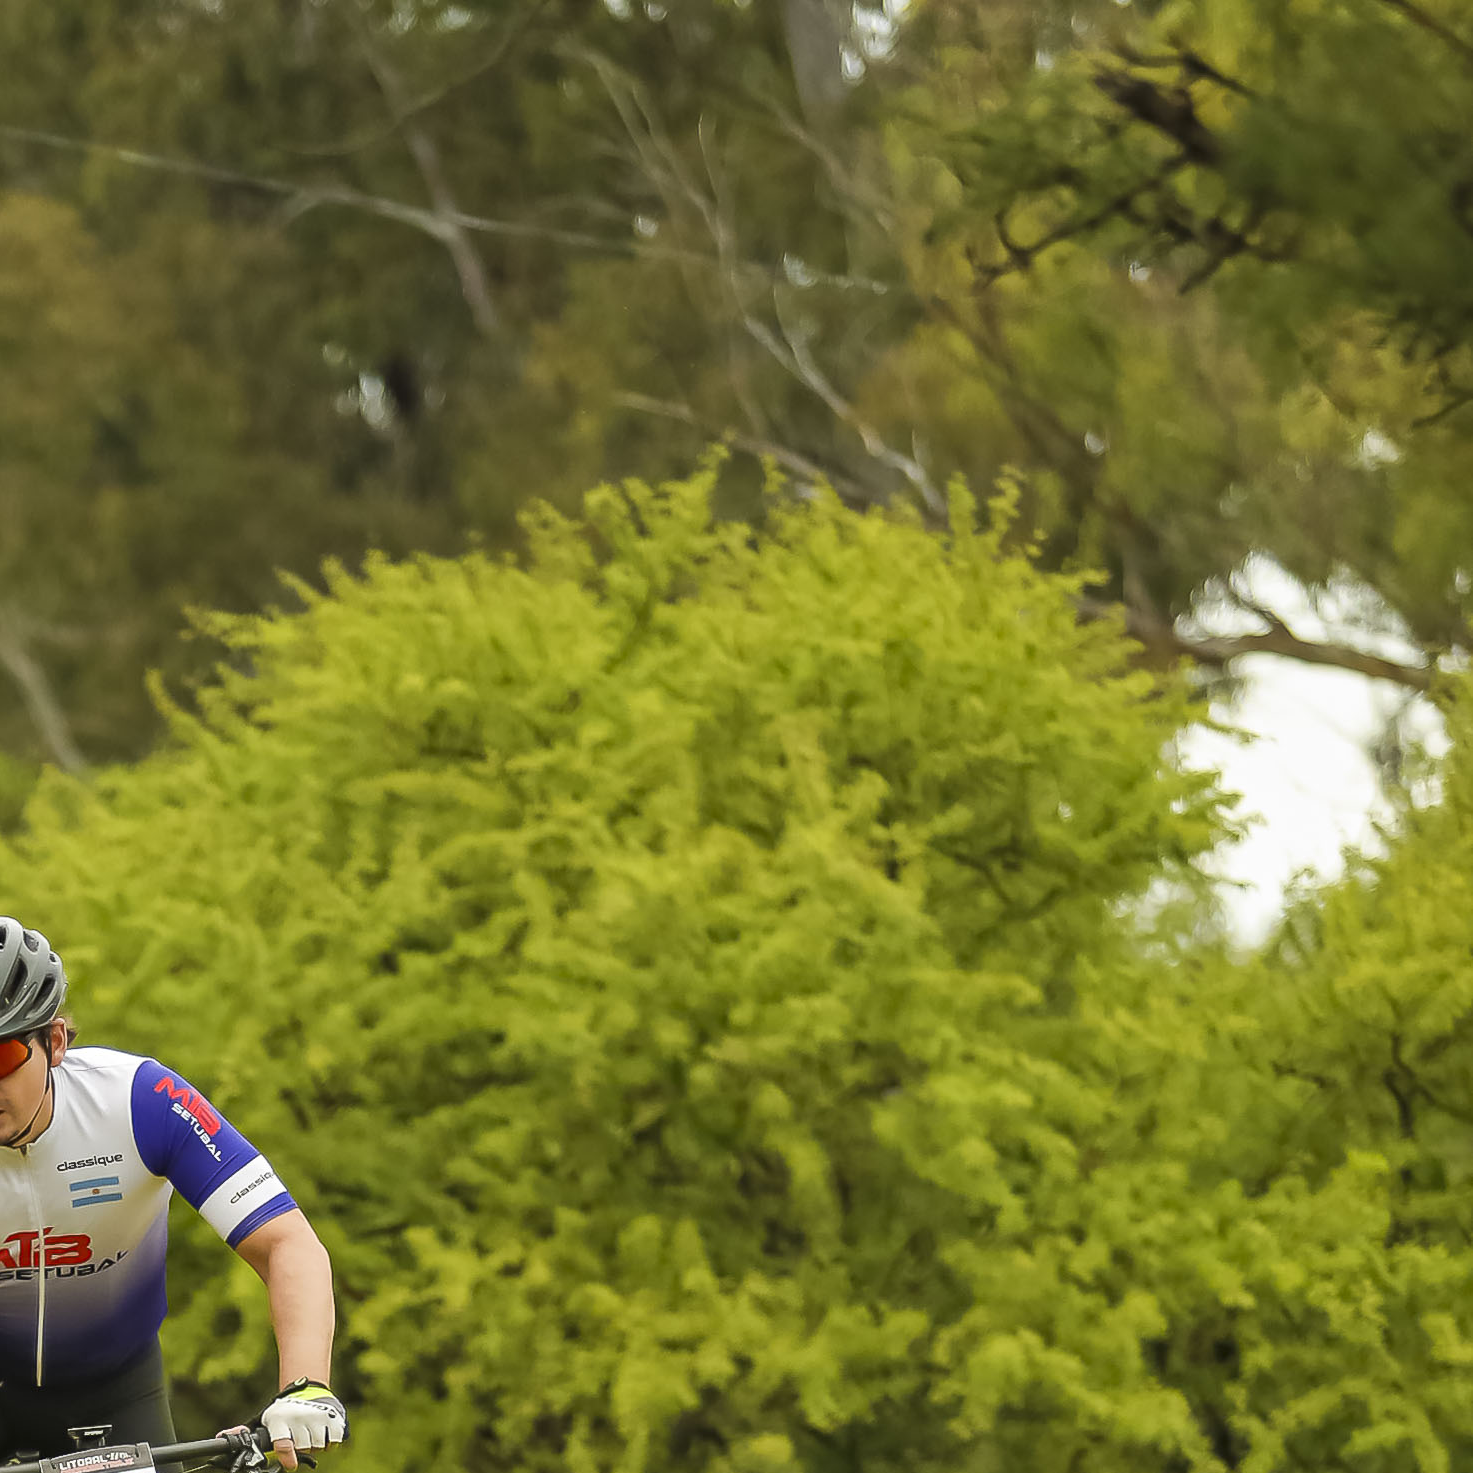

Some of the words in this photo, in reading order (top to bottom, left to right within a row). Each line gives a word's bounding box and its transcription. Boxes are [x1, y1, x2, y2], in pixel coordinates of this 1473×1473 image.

[171, 1102, 222, 1162] SETUBAL
[56, 1153, 123, 1172] classique
[230, 1171, 274, 1204] classiq
